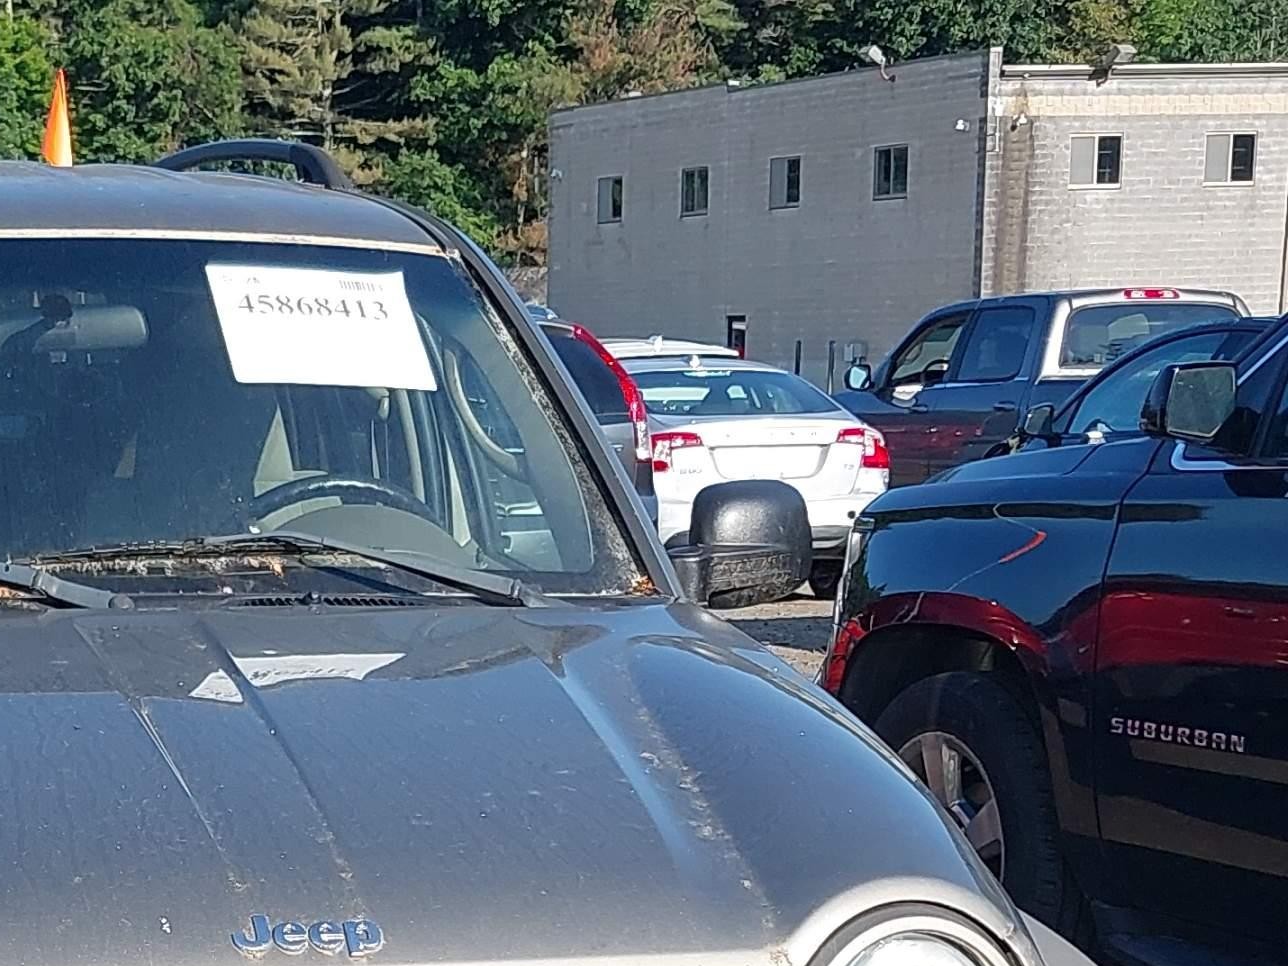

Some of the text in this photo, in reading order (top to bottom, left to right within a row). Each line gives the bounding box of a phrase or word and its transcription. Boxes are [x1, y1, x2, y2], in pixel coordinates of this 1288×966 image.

[238, 293, 389, 321] 45868413
[1110, 717, 1246, 753] SUBURBAN
[230, 913, 385, 960] Jeep
